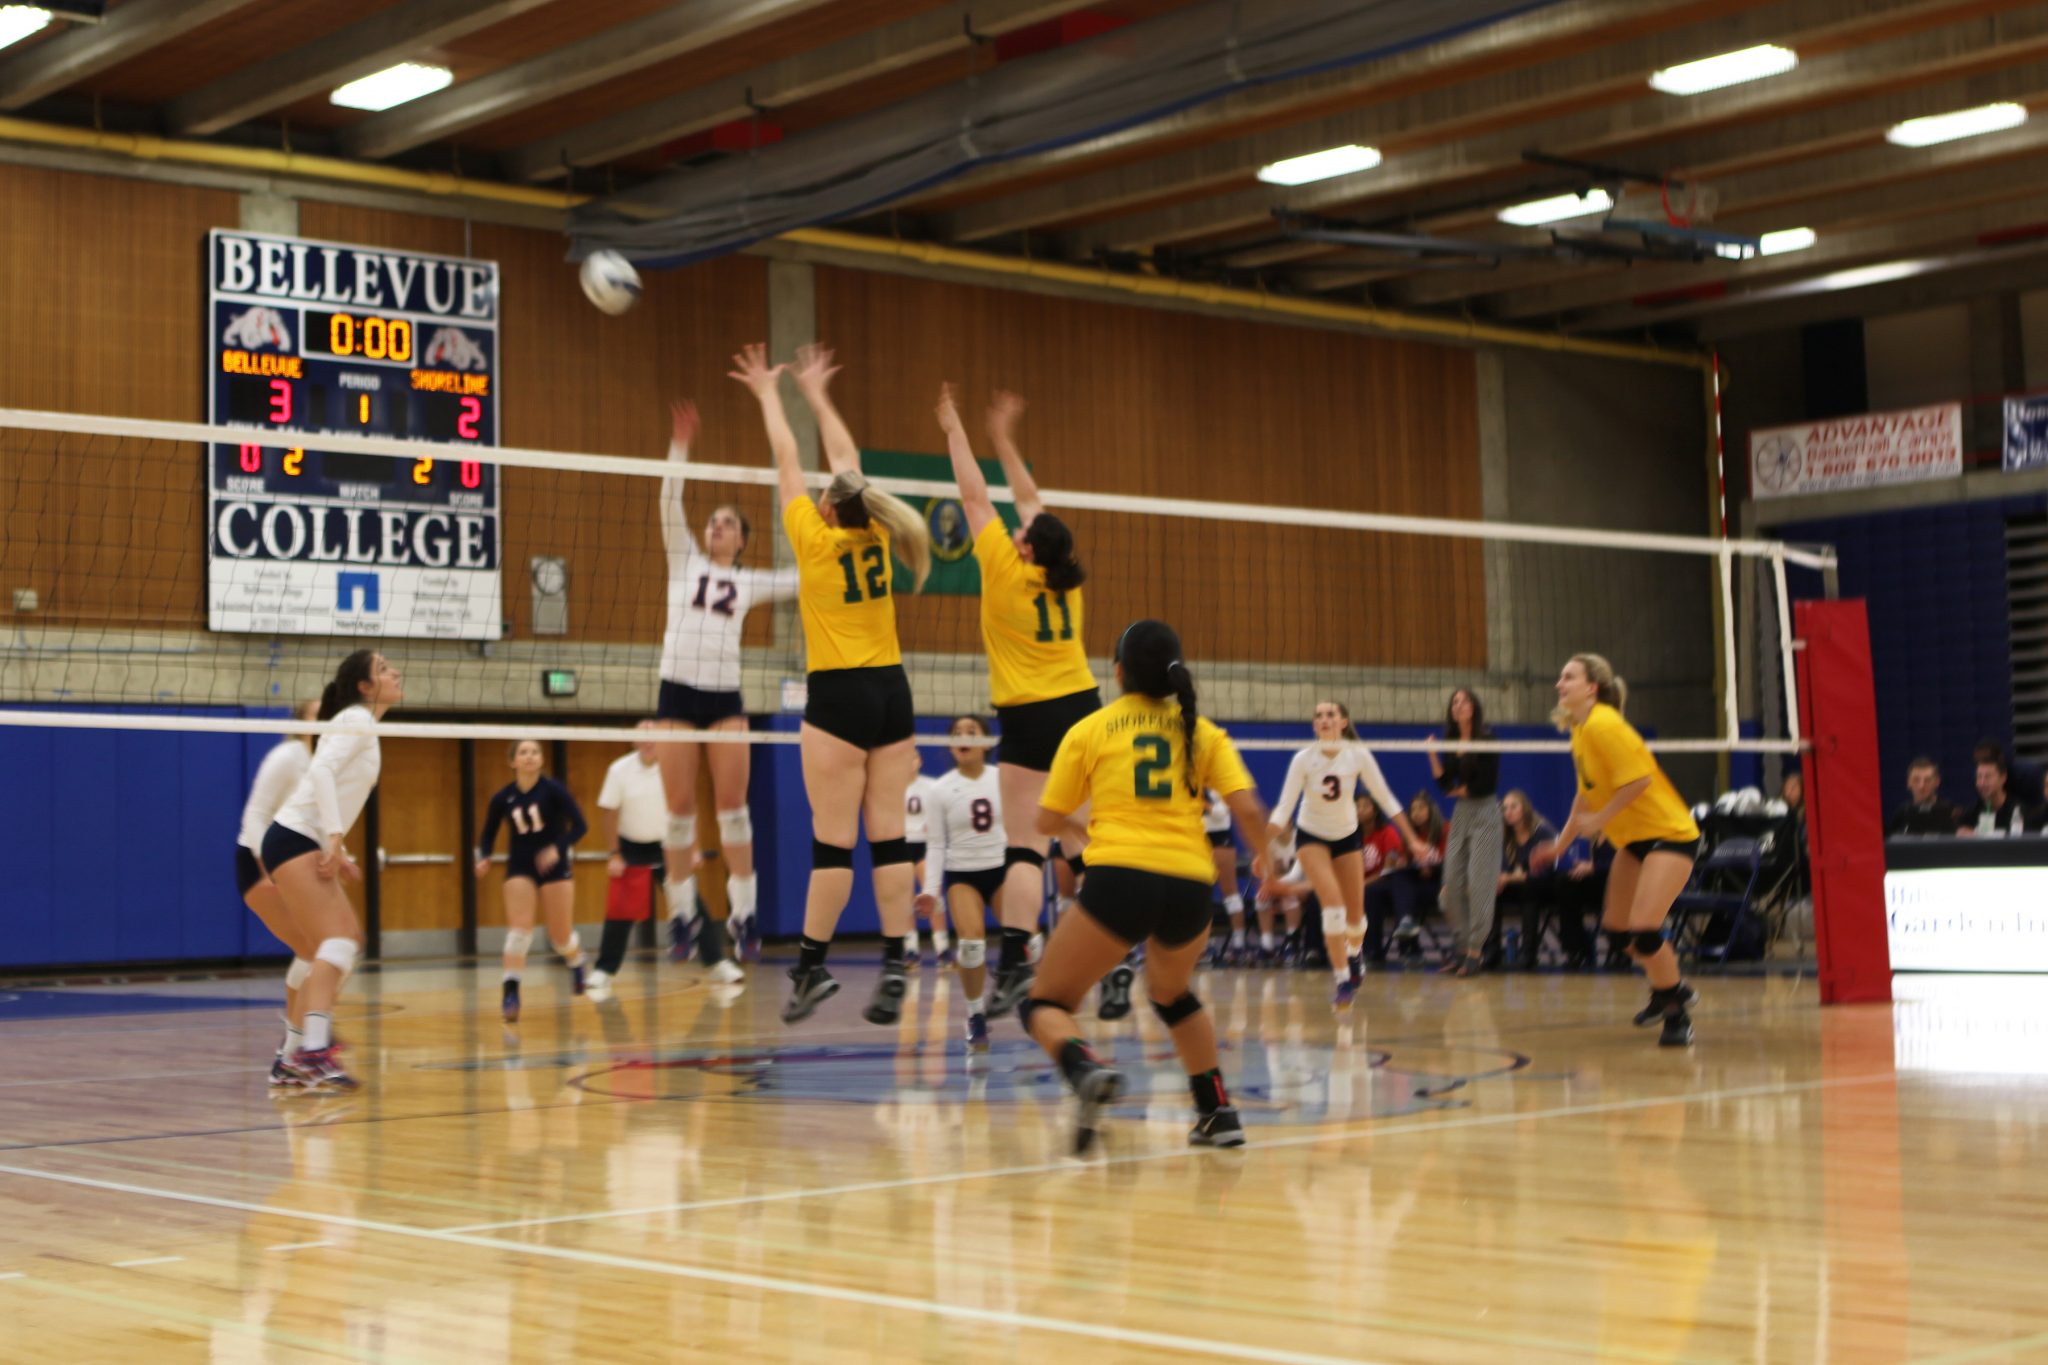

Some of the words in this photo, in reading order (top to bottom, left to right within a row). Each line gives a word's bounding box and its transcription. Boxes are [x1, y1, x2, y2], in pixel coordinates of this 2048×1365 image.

[220, 237, 490, 317] BELLEVUE
[330, 313, 411, 361] 0:00
[222, 350, 303, 379] BELLEVUE
[339, 372, 381, 390] PERIOD
[410, 369, 490, 396] SHORELINE
[269, 379, 292, 423] 3
[359, 393, 369, 424] 1
[458, 397, 481, 439] 2
[226, 476, 265, 493] SCORE
[218, 502, 487, 569] COLLEGE
[838, 545, 888, 604] 12
[692, 575, 738, 618] 12
[1033, 591, 1073, 642] 11
[1132, 731, 1172, 800] 2
[1321, 774, 1341, 801] 3
[511, 803, 545, 835] 11
[971, 797, 993, 833] 8
